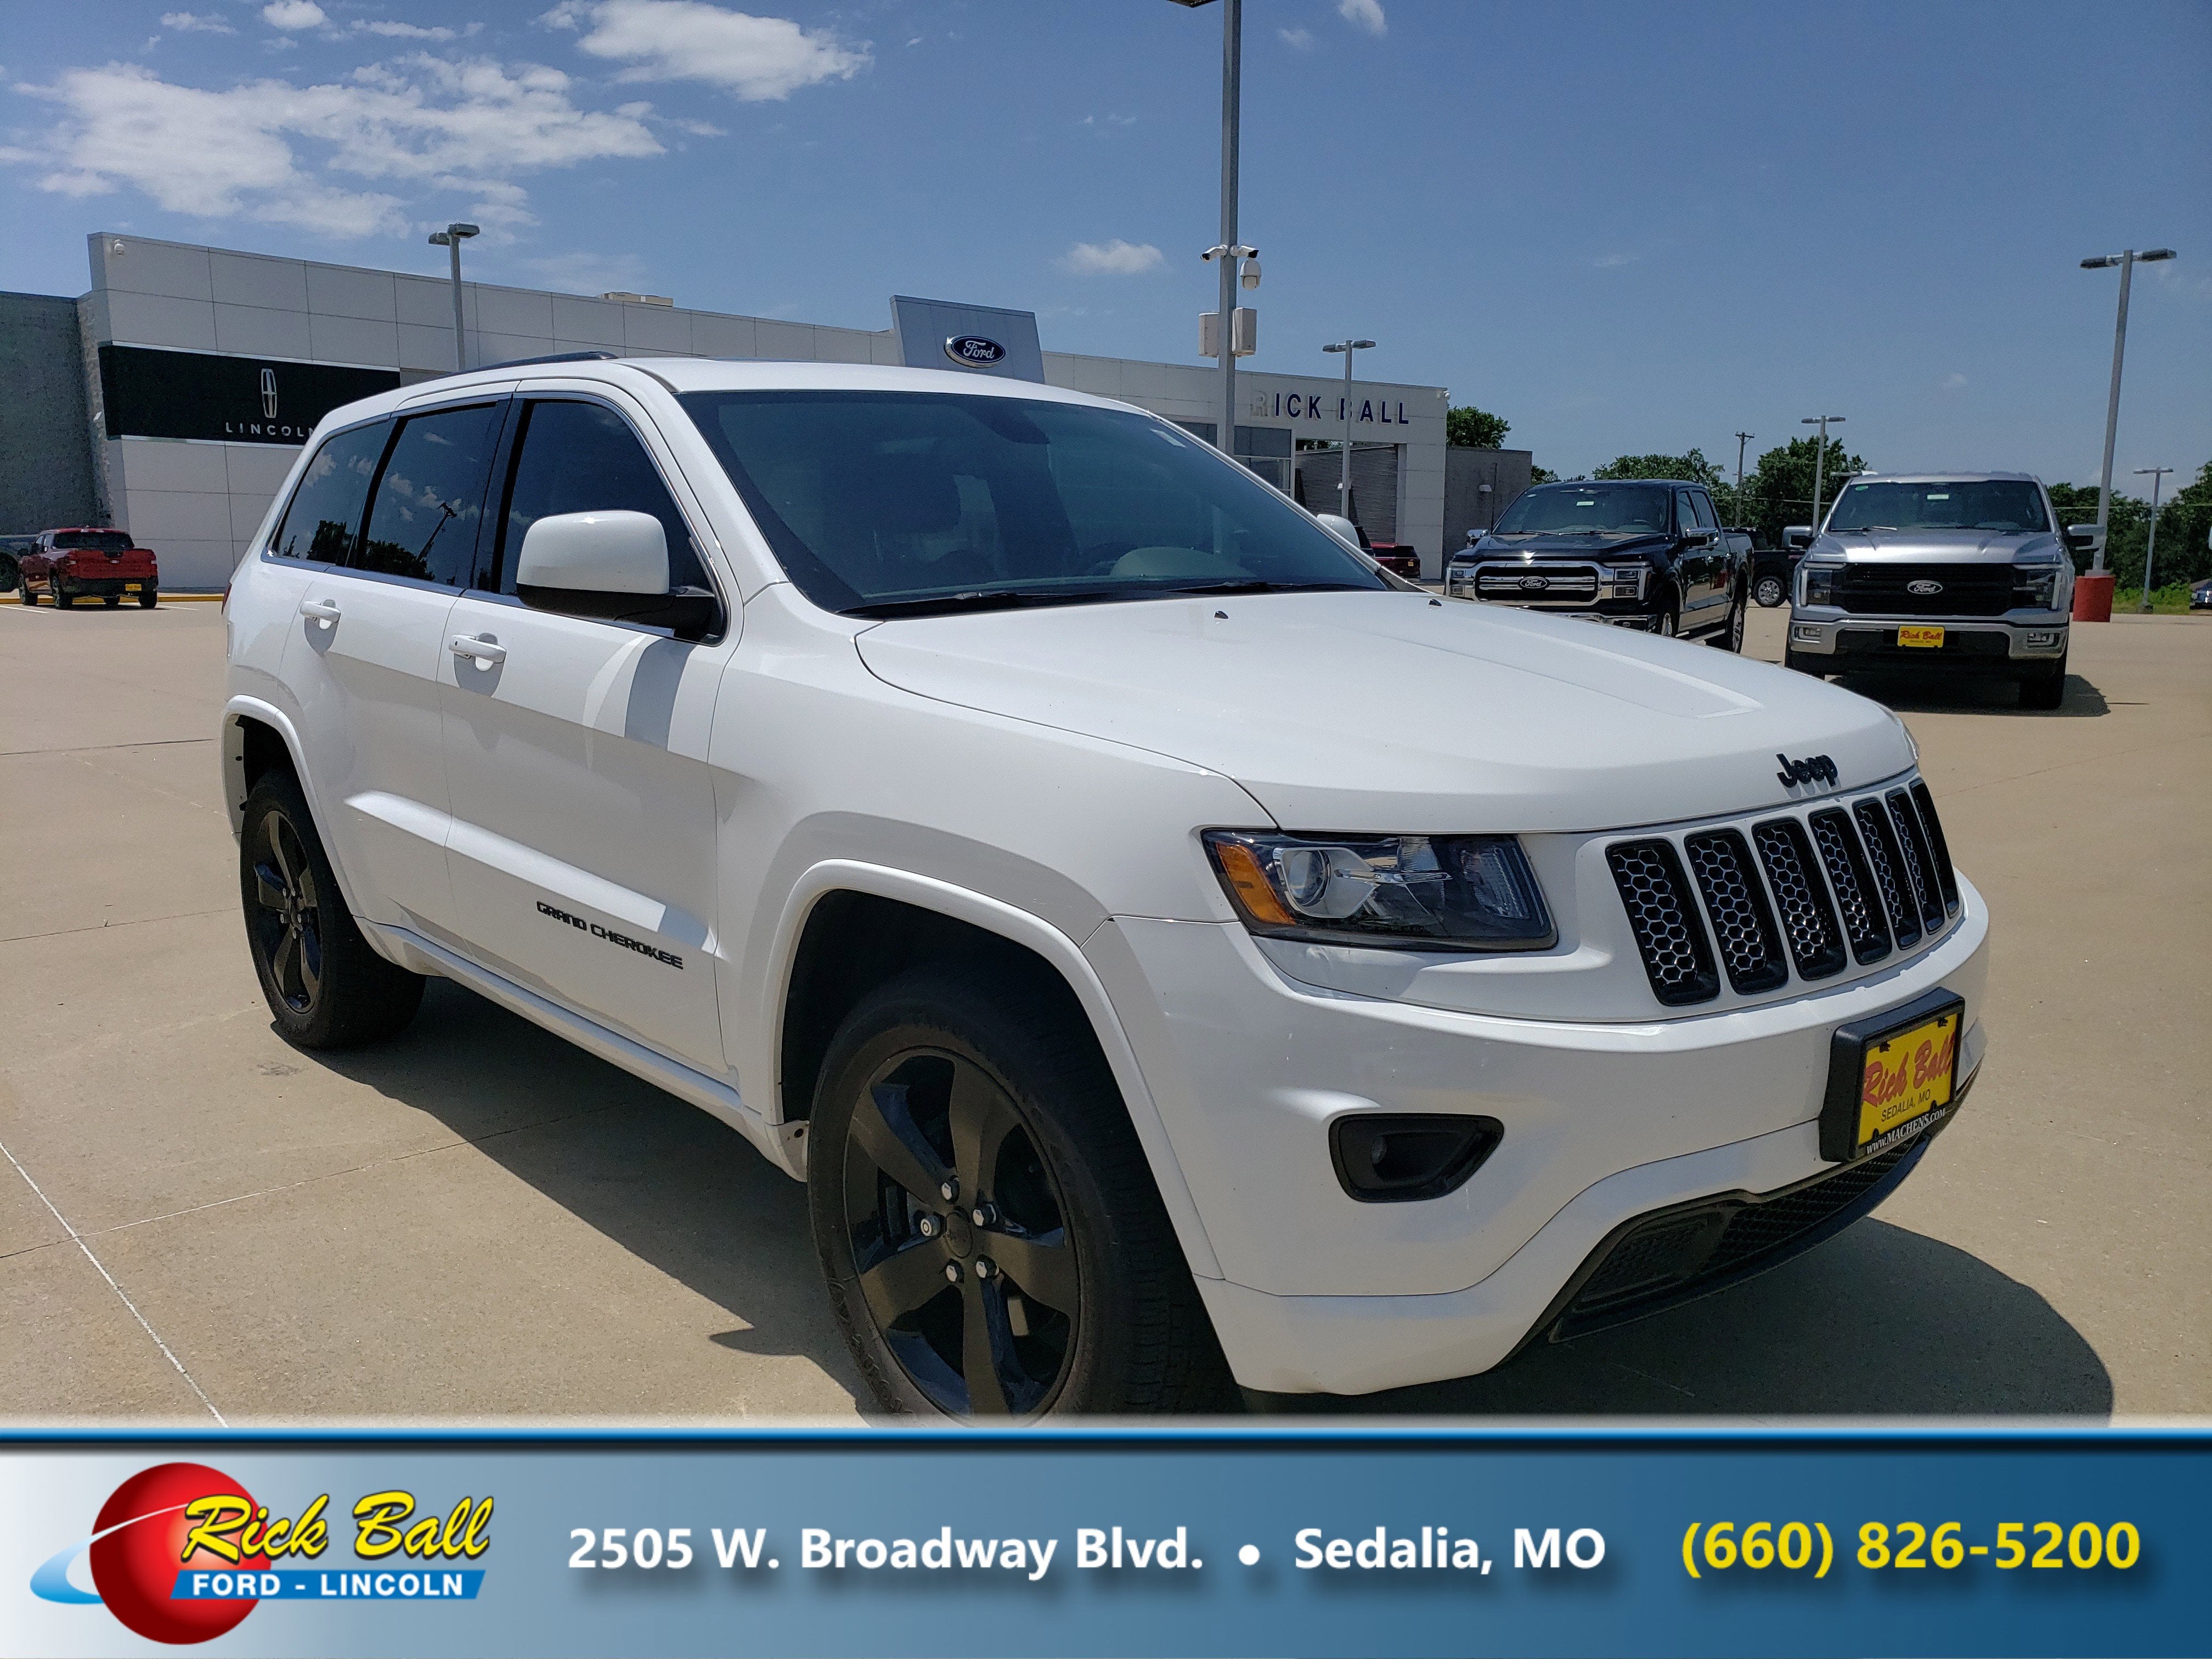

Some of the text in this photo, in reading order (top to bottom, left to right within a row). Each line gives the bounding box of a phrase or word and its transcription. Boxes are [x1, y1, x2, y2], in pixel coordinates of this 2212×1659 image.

[963, 340, 995, 359] Ford
[1250, 391, 1409, 425] RICK BALL
[1914, 583, 1937, 592] Ford
[1776, 753, 1838, 788] Jeep
[537, 901, 684, 970] GRAND CHEROKEE
[1863, 1031, 1956, 1108] Rick Ball
[1881, 1088, 1931, 1122] SEDALIA, MO
